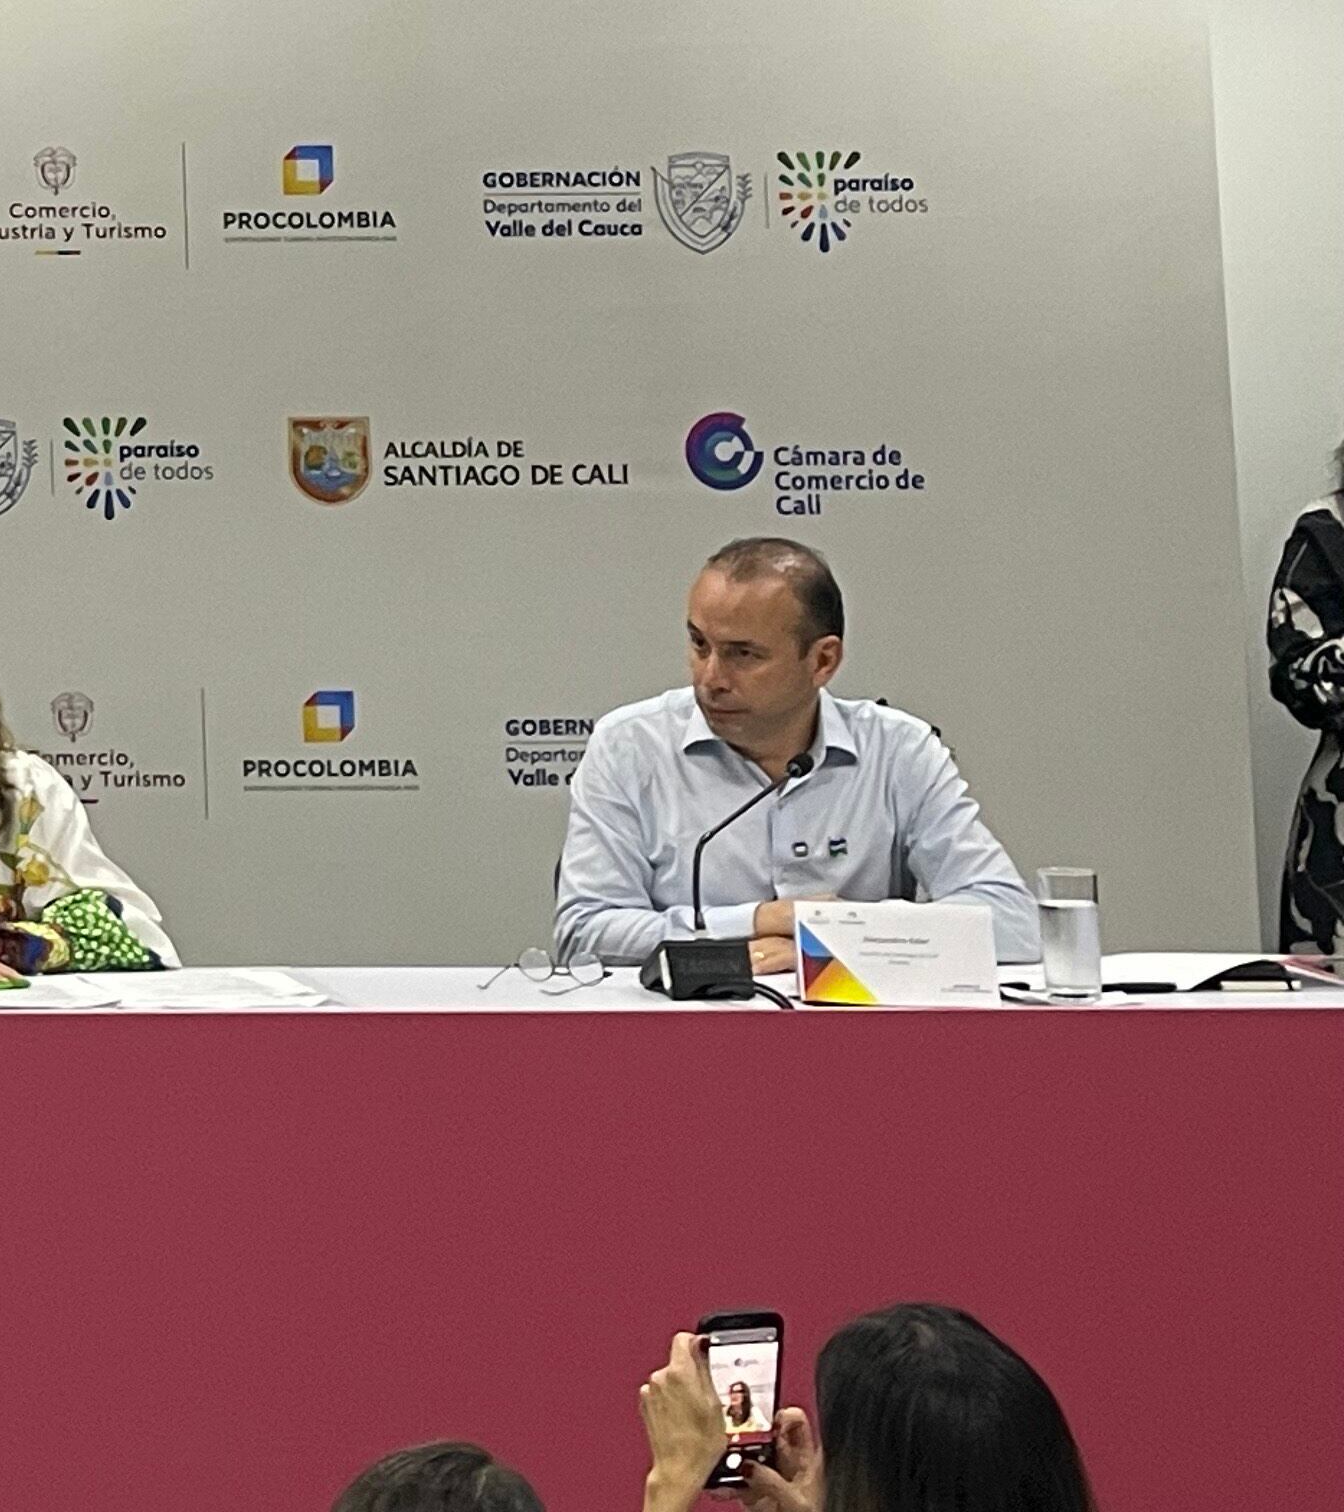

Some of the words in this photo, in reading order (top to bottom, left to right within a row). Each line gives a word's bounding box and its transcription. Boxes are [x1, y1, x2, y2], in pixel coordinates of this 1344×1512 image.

[482, 170, 641, 189] GOBERNACIÓN
[833, 175, 914, 197] paraíso
[8, 202, 116, 221] Comercio,
[223, 210, 397, 230] PROCOLOMBIA
[62, 227, 75, 243] y
[81, 222, 167, 240] Turismo
[484, 219, 536, 238] Valle
[541, 218, 573, 237] del
[577, 219, 643, 237] Cauca
[119, 439, 200, 463] paraíso
[383, 436, 490, 459] ALCALDÍA
[496, 440, 525, 459] DE
[773, 444, 866, 467] Cámara
[872, 443, 902, 466] de
[119, 462, 147, 481] de
[153, 460, 214, 481] todos
[383, 464, 520, 487] SANTIAGO
[531, 464, 564, 486] DE
[571, 463, 629, 486] CALI
[774, 468, 890, 491] Comercio
[895, 467, 925, 490] de
[775, 493, 821, 516] Cali
[242, 759, 419, 778] PROCOLOMBIA
[507, 768, 560, 787] Valle
